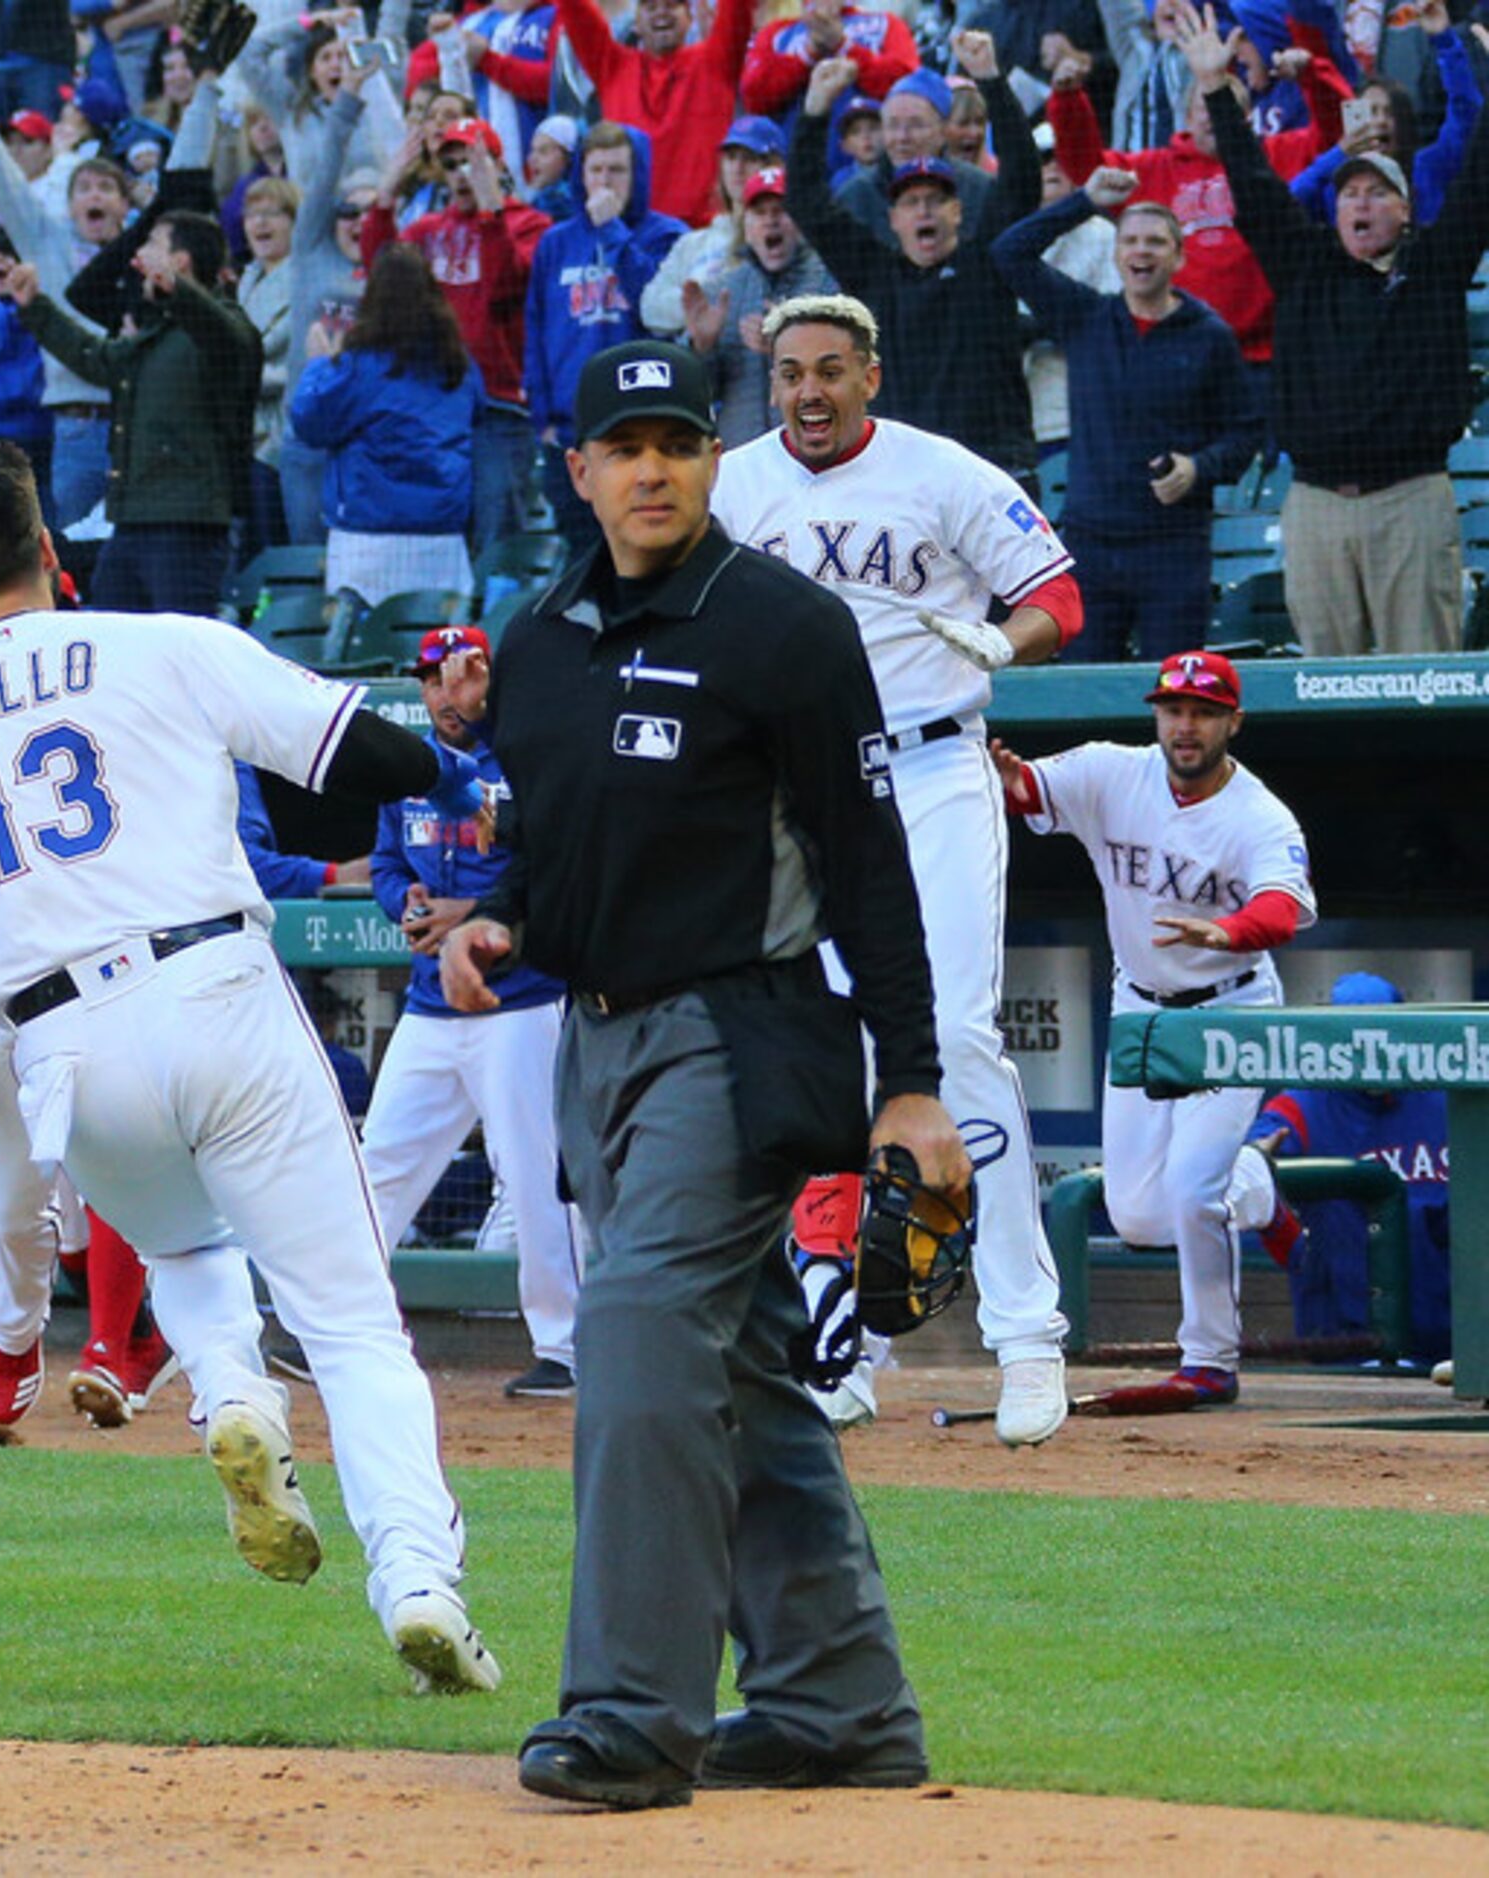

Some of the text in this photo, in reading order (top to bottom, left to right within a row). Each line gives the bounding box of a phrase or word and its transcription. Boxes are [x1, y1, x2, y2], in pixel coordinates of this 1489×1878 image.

[438, 629, 464, 646] T
[1178, 655, 1204, 681] T
[1105, 841, 1249, 913] TEXAS
[1203, 1025, 1489, 1081] DallasTruck
